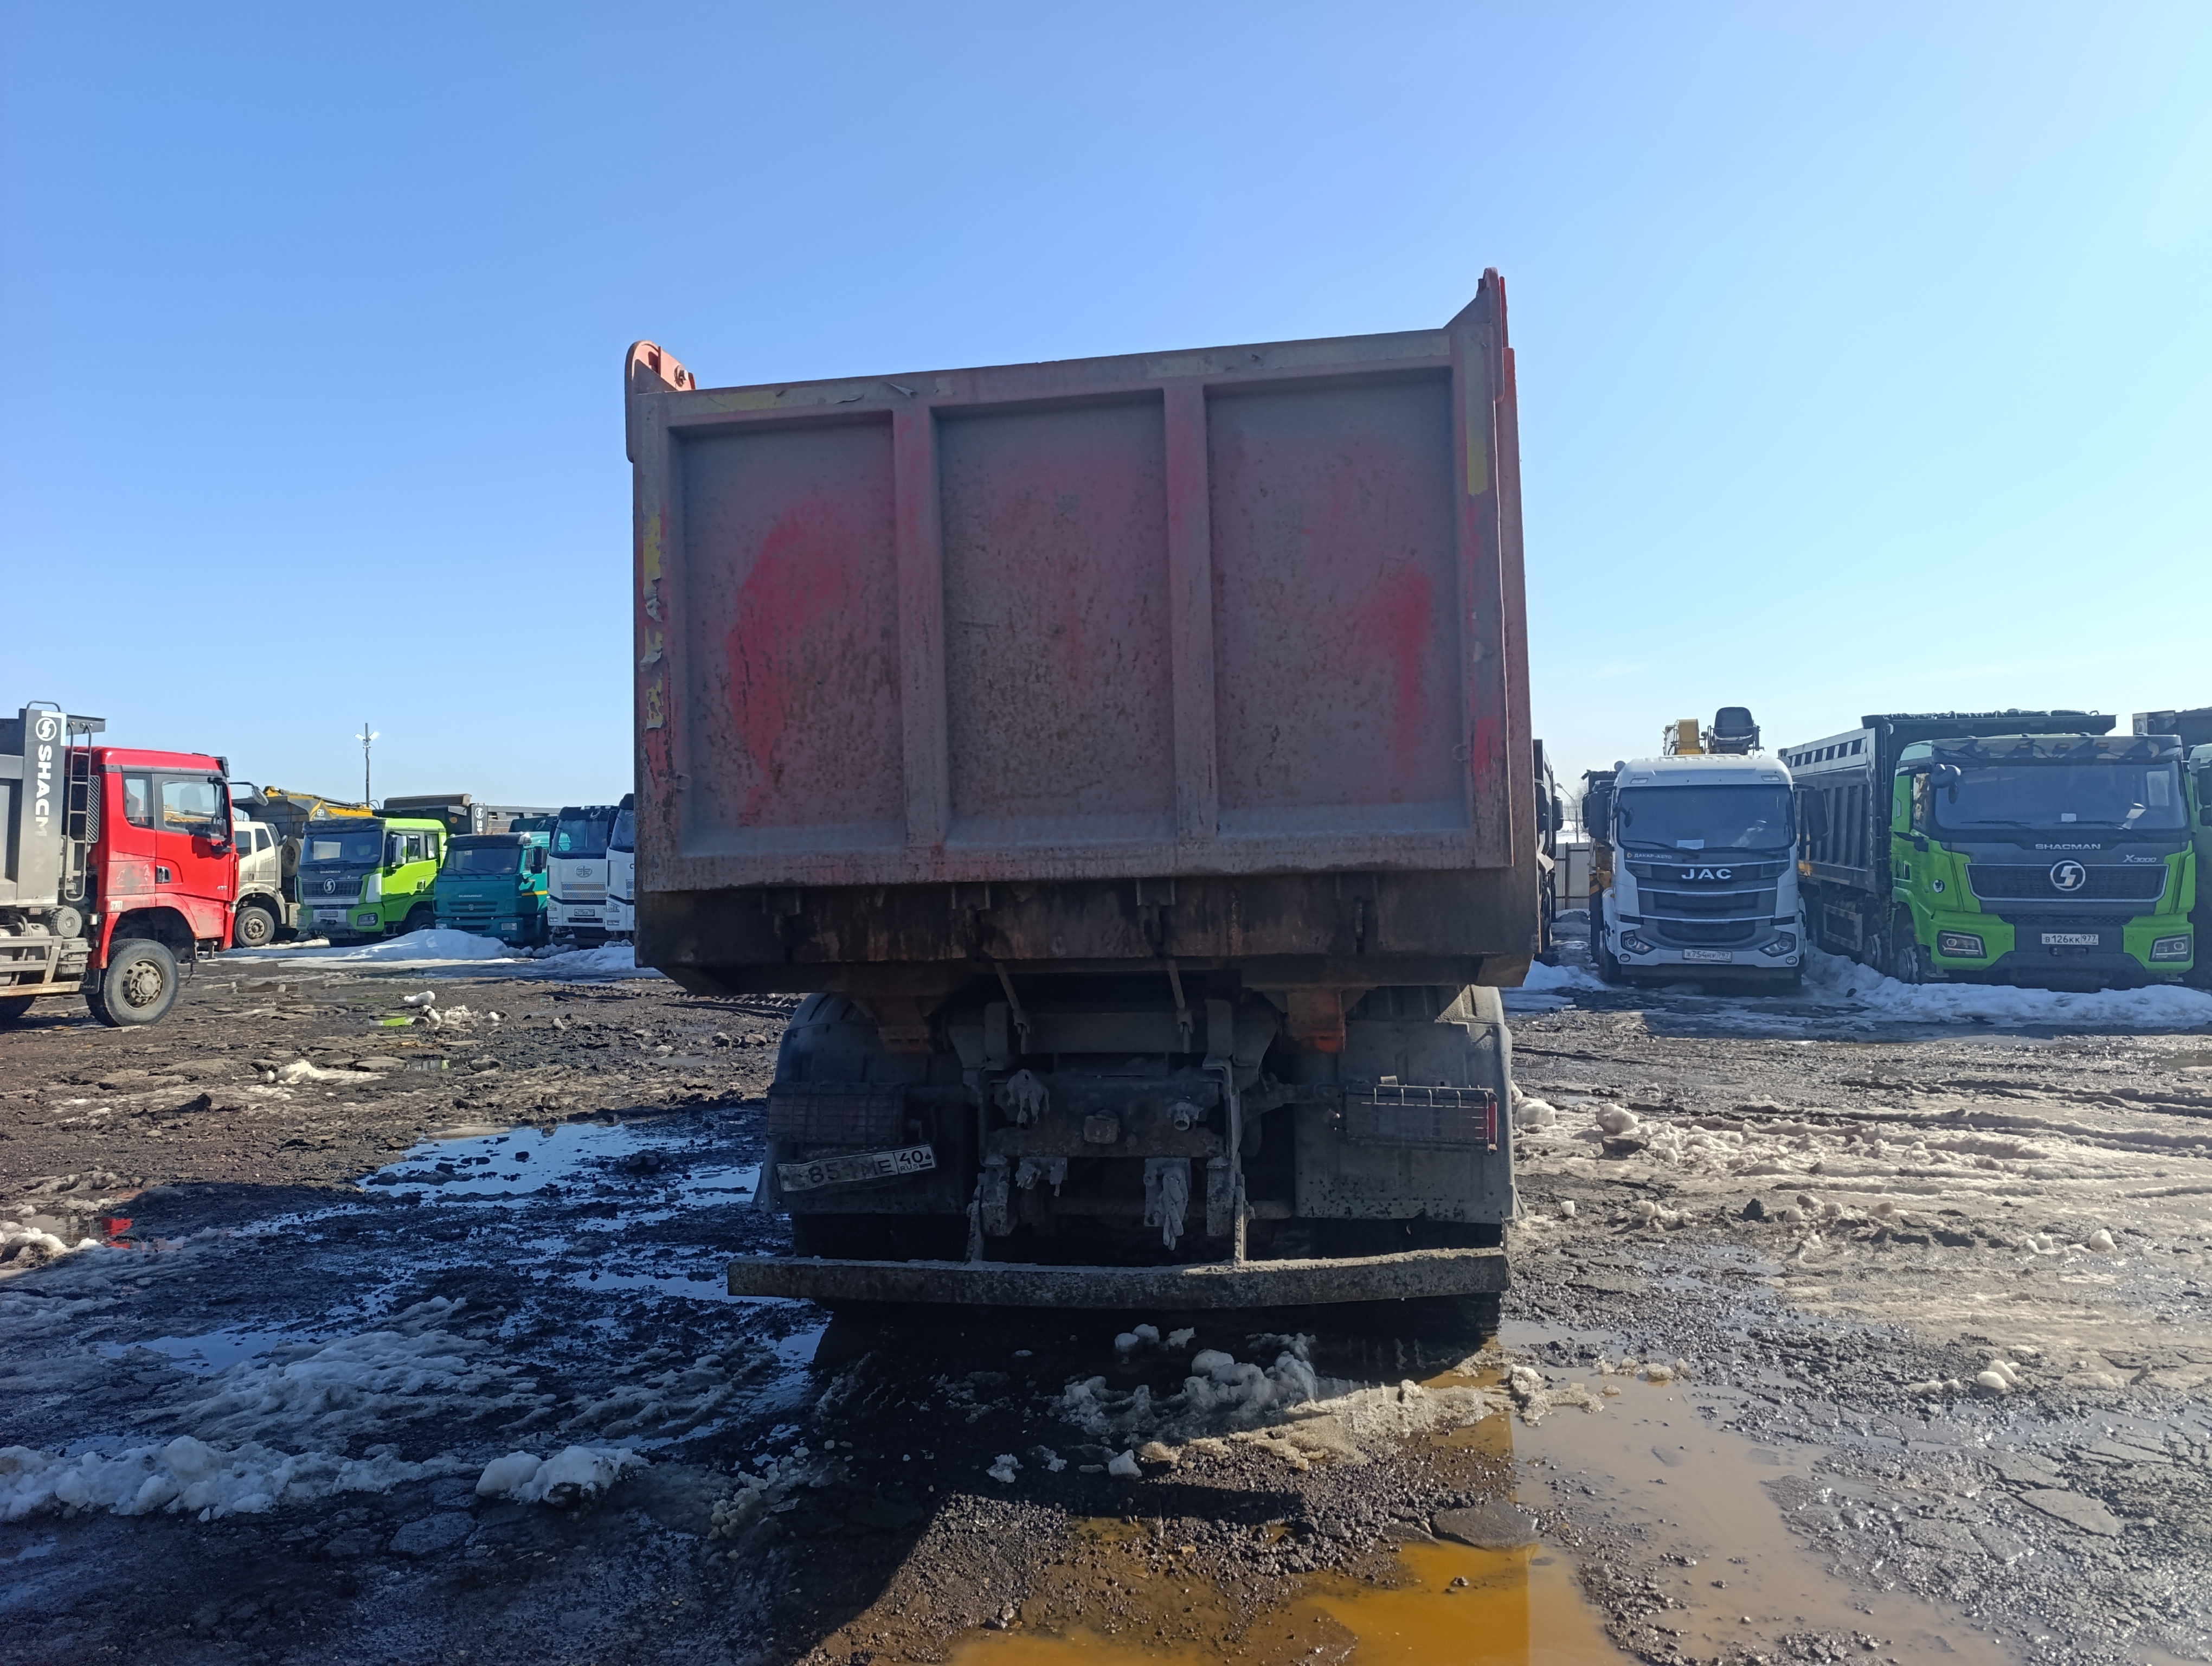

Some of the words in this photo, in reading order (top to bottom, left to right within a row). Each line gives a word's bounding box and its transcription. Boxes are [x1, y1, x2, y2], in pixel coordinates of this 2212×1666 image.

[2123, 854, 2157, 863] X3000
[1681, 868, 1732, 879] JAC
[2045, 935, 2080, 943] В126КК
[899, 1150, 924, 1164] 40
[899, 1163, 919, 1171] RUS
